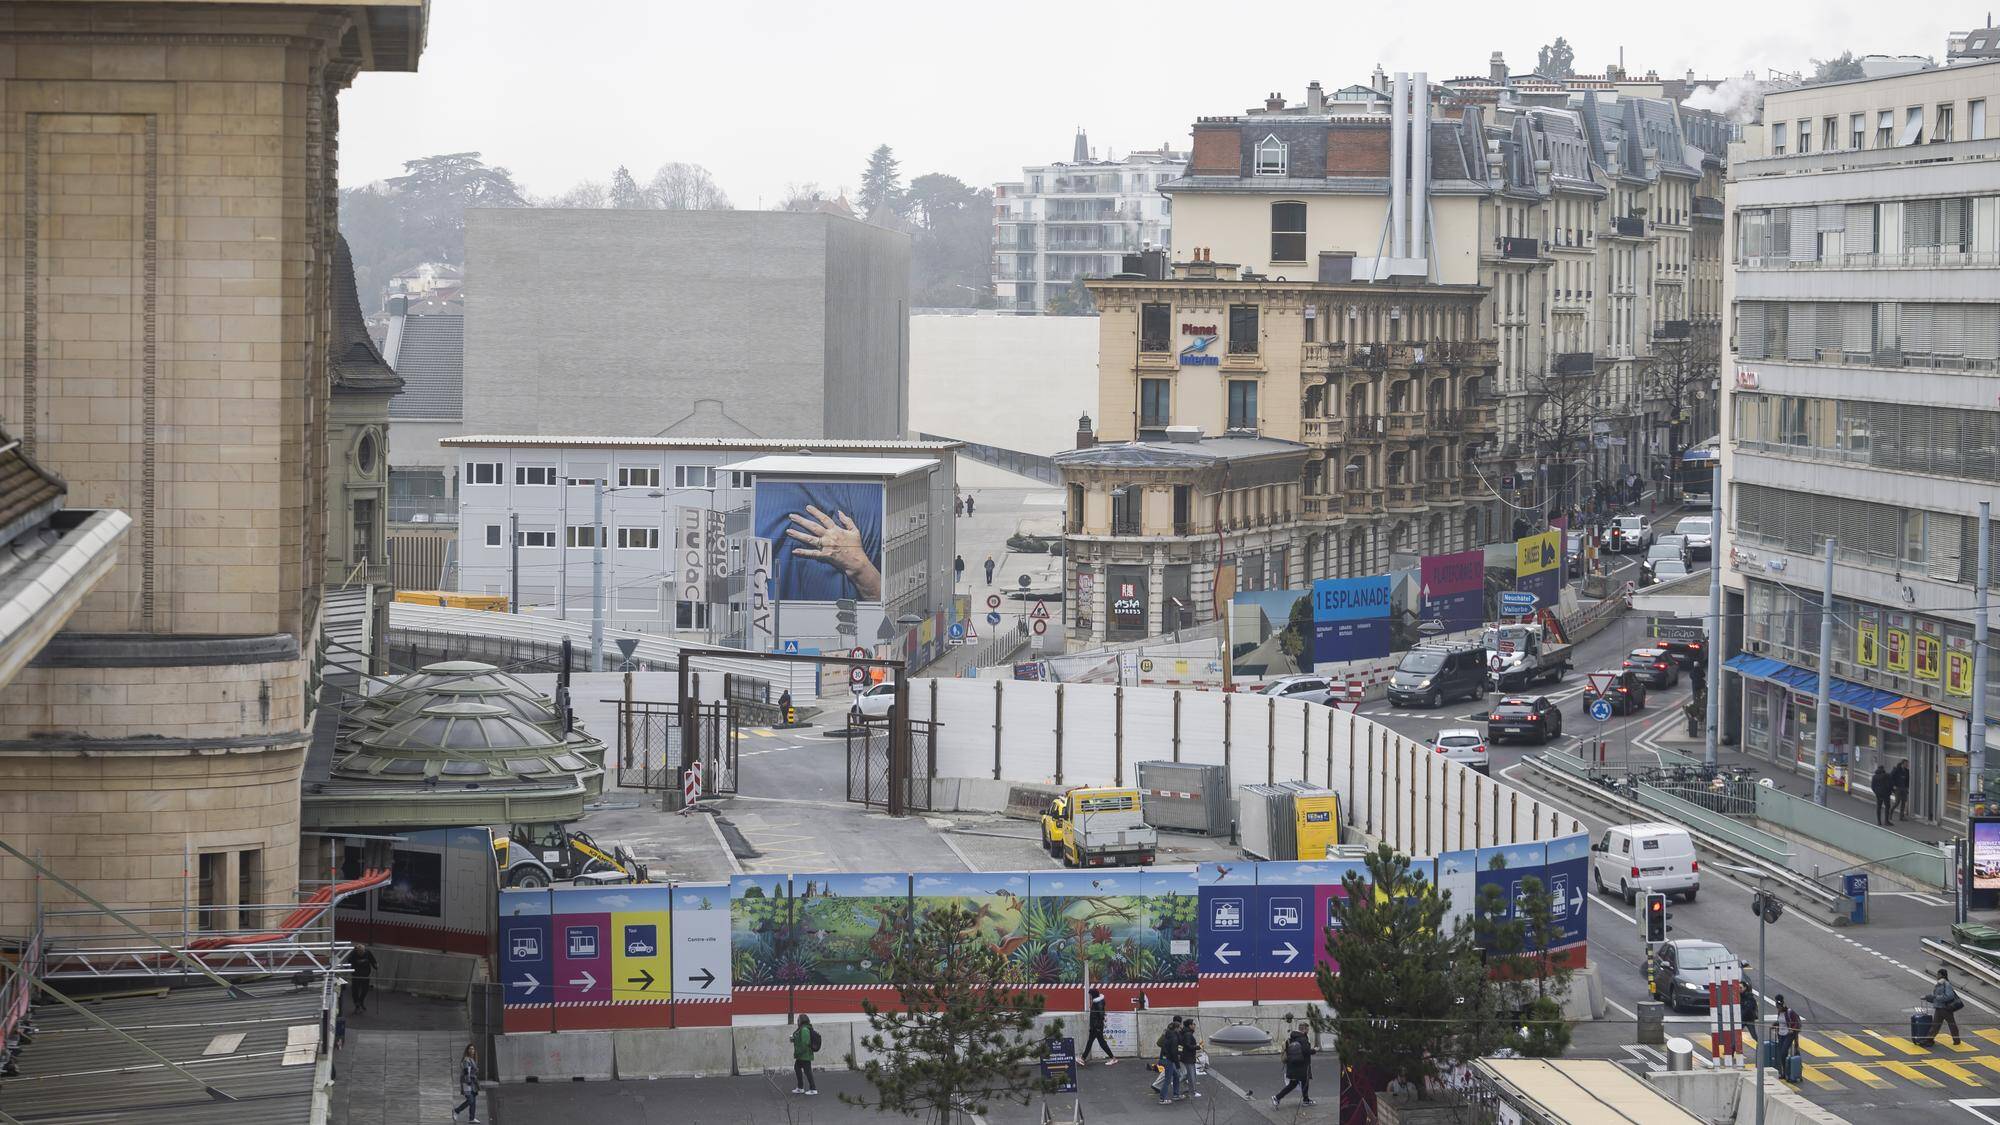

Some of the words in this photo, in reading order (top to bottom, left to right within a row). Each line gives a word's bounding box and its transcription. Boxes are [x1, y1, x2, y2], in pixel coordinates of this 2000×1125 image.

[1182, 323, 1217, 335] Planet
[1180, 354, 1219, 366] Interim
[716, 512, 728, 578] PHOTO
[686, 509, 704, 600] mudac
[1114, 599, 1140, 608] ASIA
[1316, 592, 1321, 610] 1
[1325, 586, 1389, 610] ESPLANADE
[1504, 594, 1531, 602] Neuchâtel
